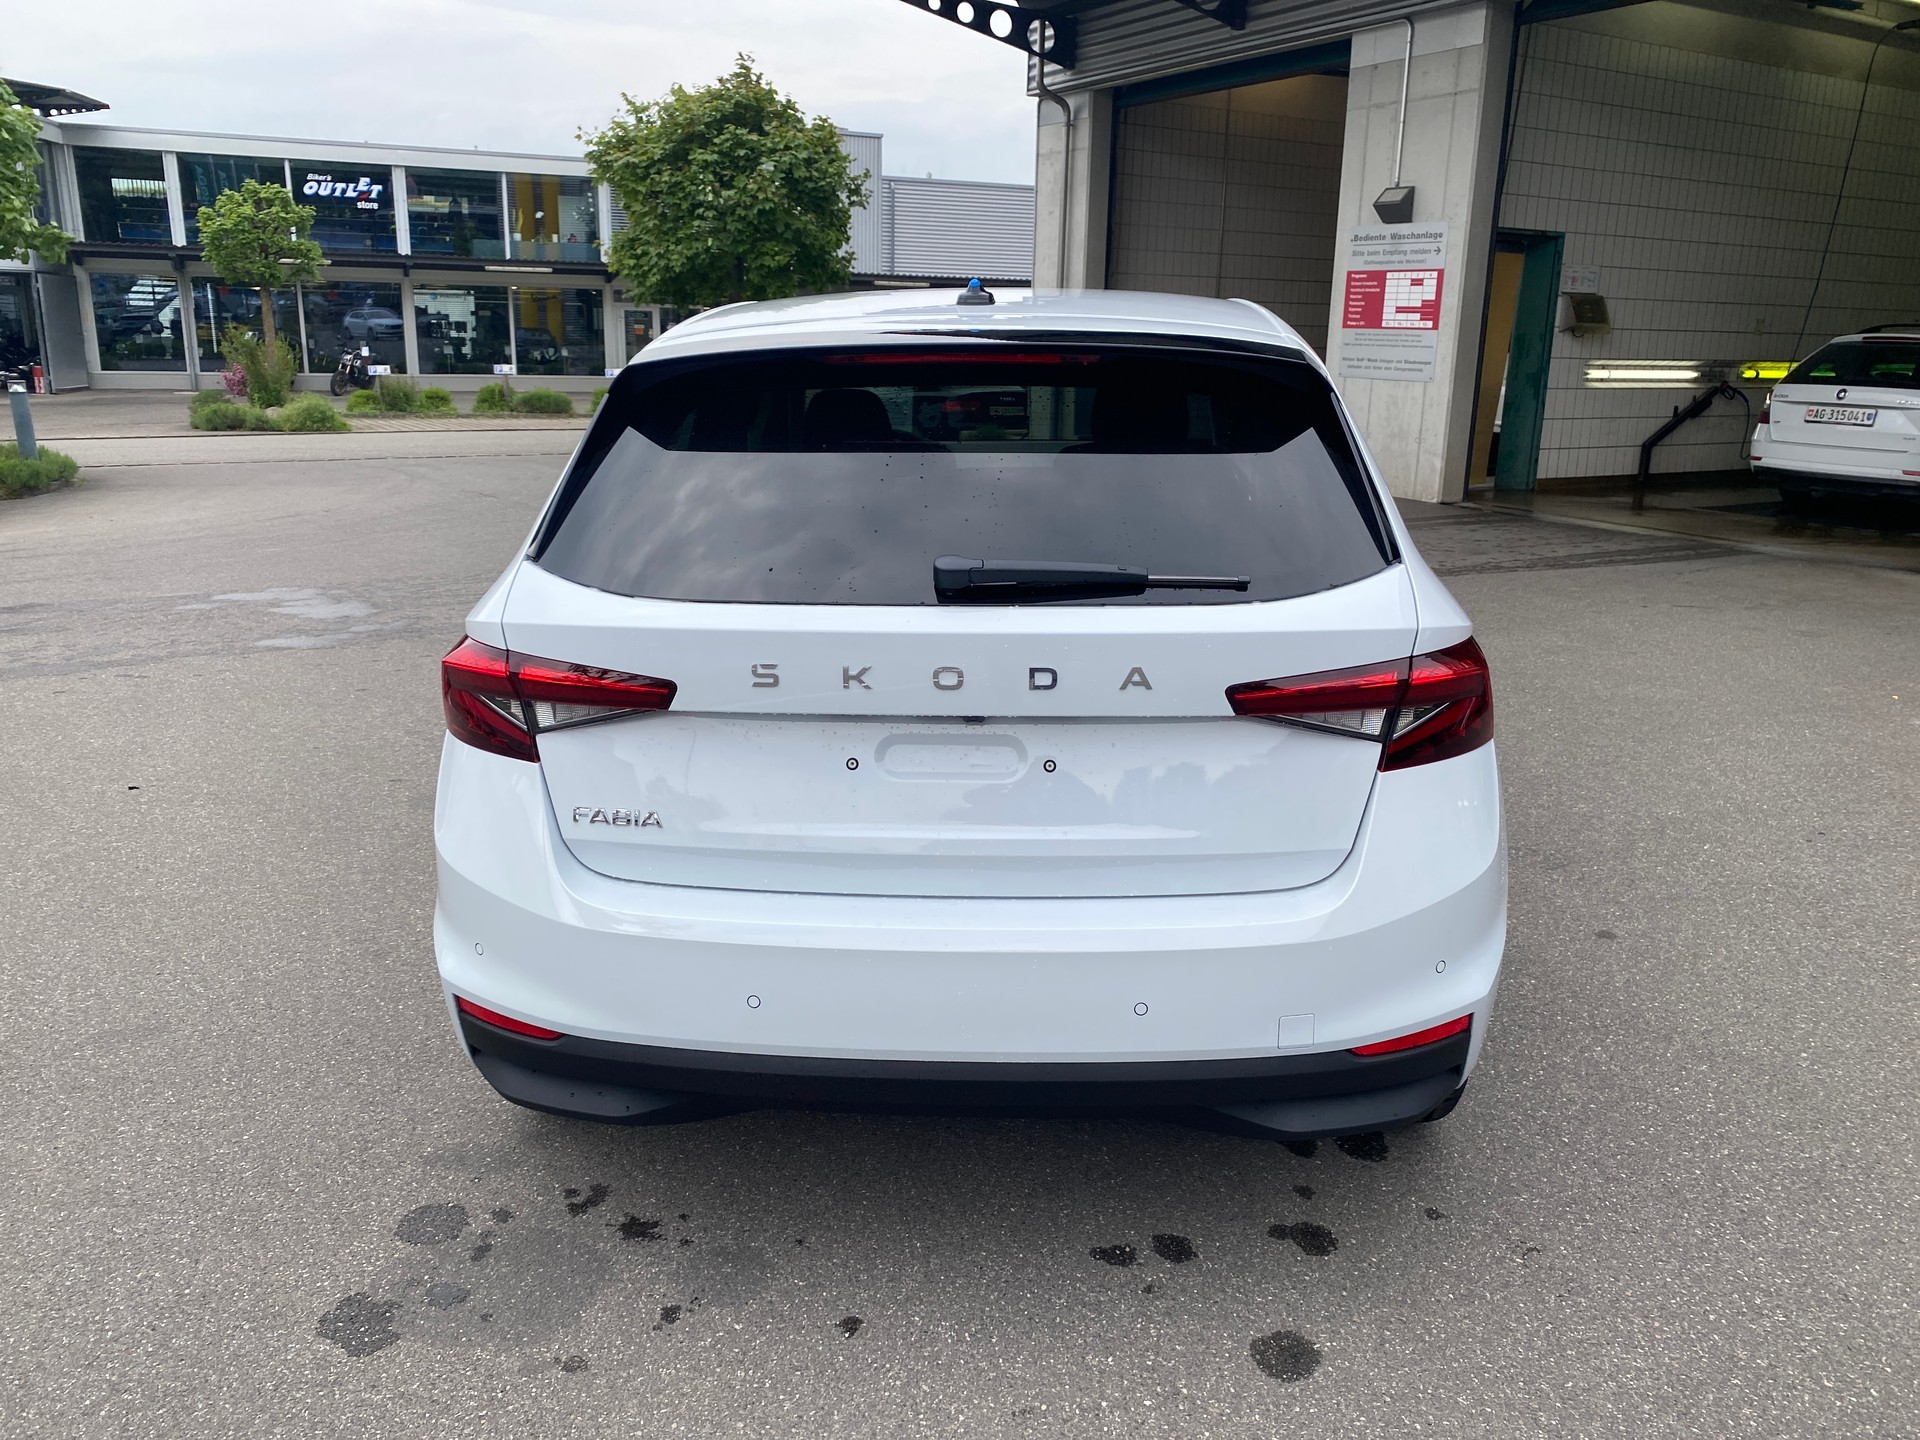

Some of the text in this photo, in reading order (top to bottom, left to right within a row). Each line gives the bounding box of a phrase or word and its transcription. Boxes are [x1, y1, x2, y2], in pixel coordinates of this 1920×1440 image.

[306, 173, 332, 181] Biker's
[303, 177, 383, 198] OUTLET
[356, 201, 379, 210] store
[1353, 231, 1443, 242] Bediente Waschanlage
[1382, 248, 1408, 257] Empfang
[573, 806, 663, 828] FABIA
